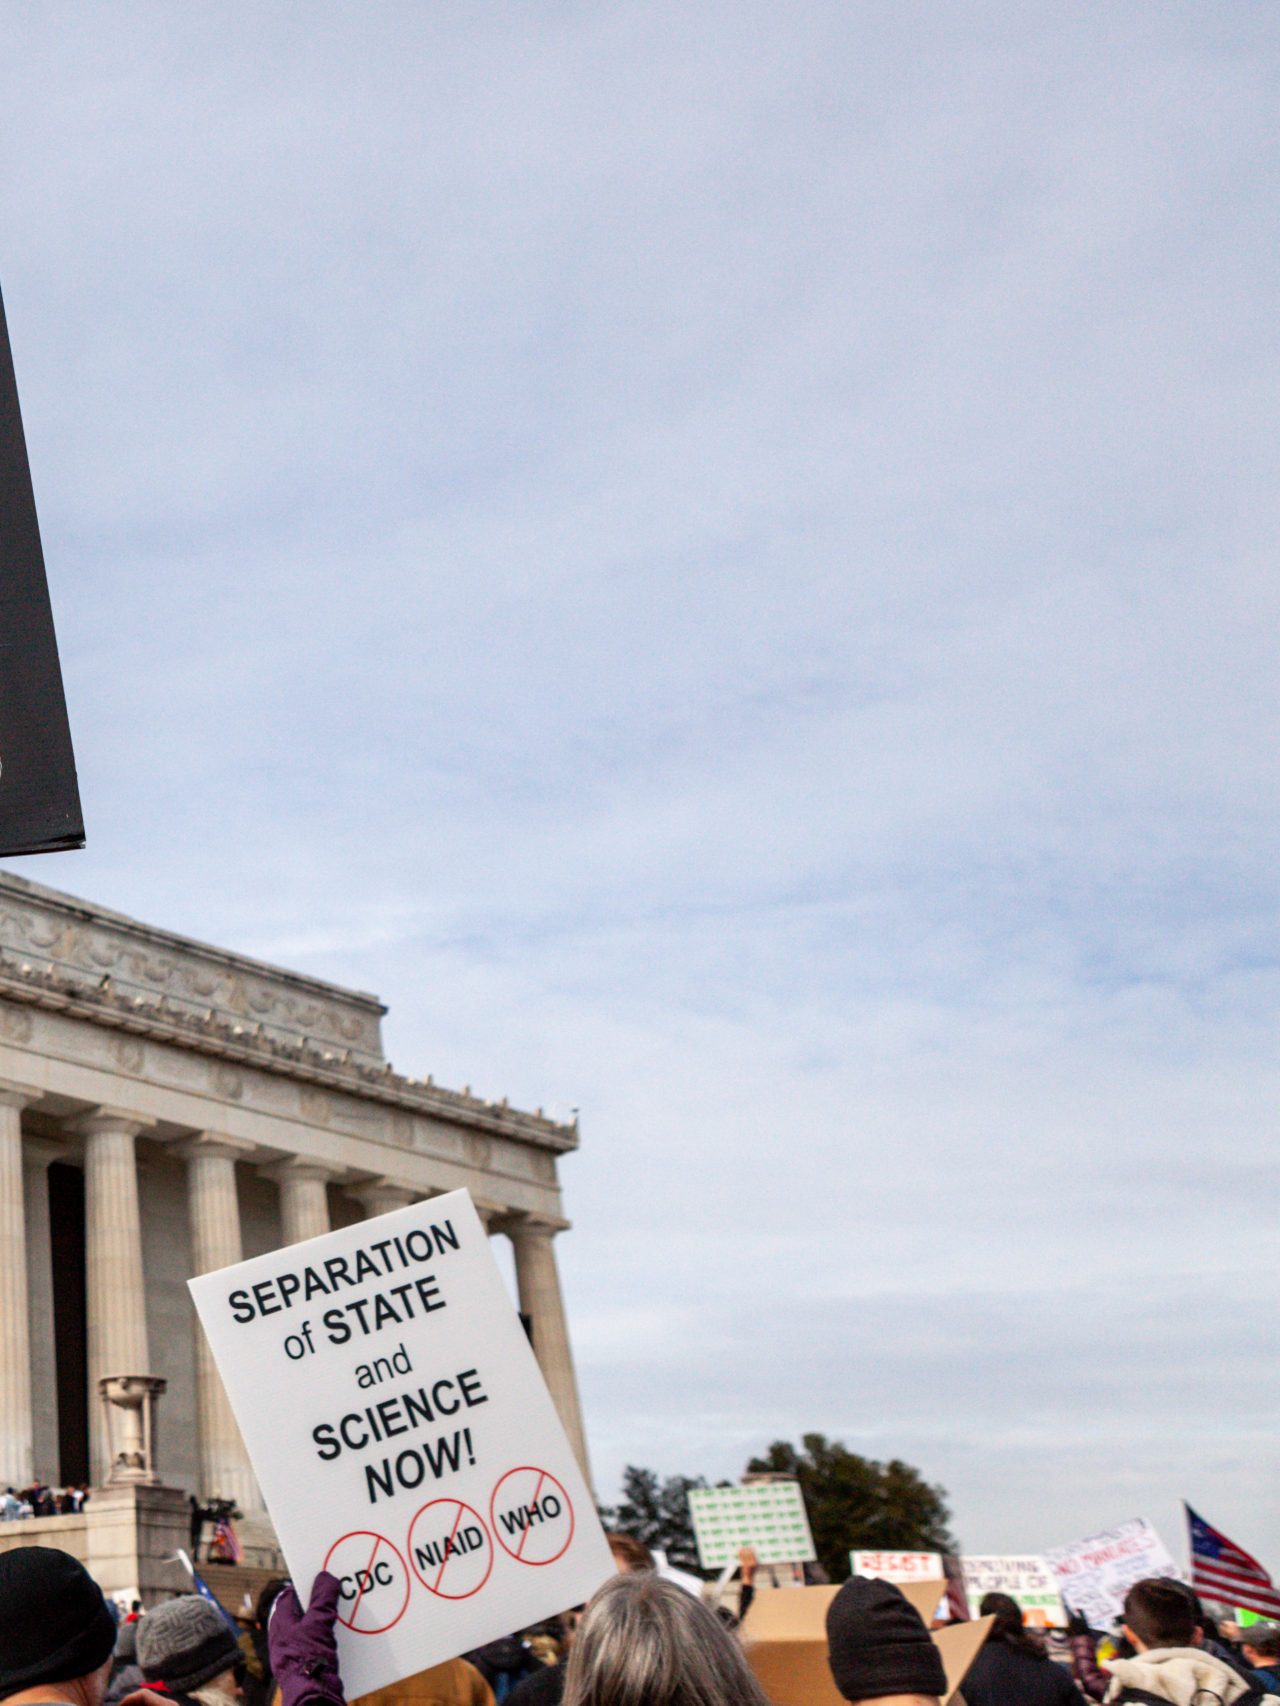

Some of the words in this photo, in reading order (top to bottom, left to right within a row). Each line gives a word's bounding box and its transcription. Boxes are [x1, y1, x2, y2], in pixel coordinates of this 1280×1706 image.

[228, 1219, 461, 1324] SEPARATION
[283, 1320, 317, 1361] of
[322, 1275, 447, 1345] STATE
[354, 1342, 413, 1389] and
[312, 1368, 489, 1461] SCIENCE
[364, 1427, 476, 1504] NOW!
[338, 1561, 394, 1601] CDC
[414, 1525, 484, 1571] NIAID
[498, 1494, 562, 1536] WHO
